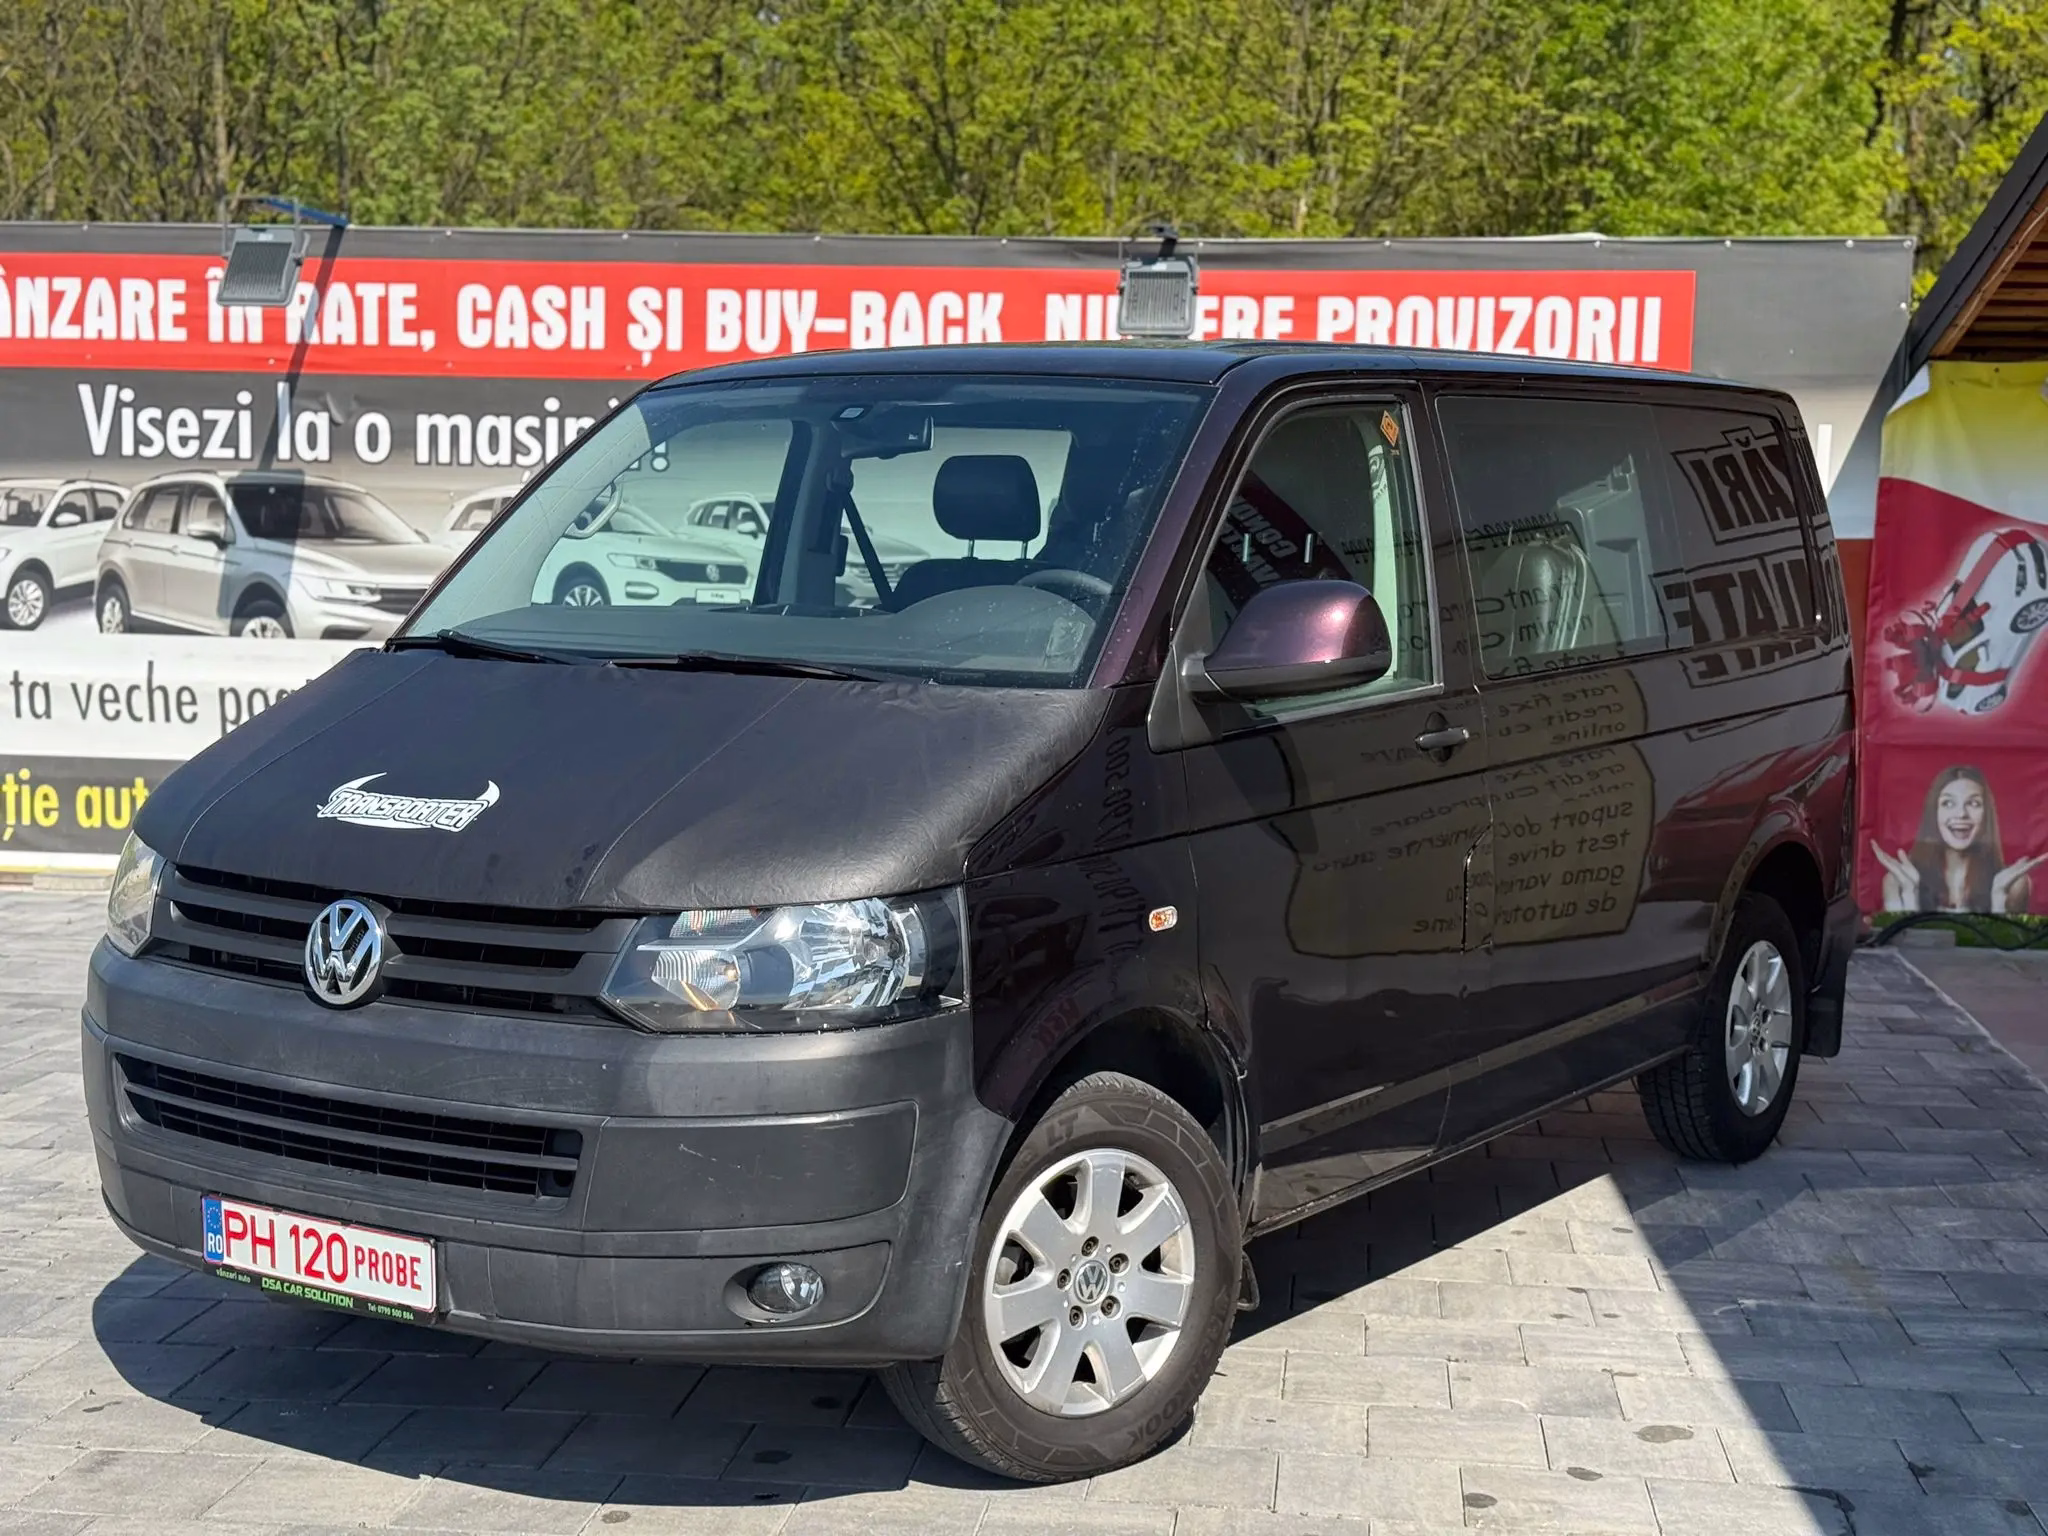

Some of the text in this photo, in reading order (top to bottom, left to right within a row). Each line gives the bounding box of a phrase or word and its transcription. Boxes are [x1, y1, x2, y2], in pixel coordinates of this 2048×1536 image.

[285, 281, 436, 352] RATE,
[455, 284, 606, 352] CASH
[626, 286, 684, 367] ȘI
[1045, 293, 1294, 342] NUERE
[1317, 294, 1662, 363] PROVIZORII
[78, 382, 254, 461] Visezi
[277, 381, 333, 464] la
[354, 412, 393, 466] o
[10, 669, 52, 721] ta
[71, 660, 199, 725] veche
[1, 767, 150, 841] ție aut
[320, 788, 487, 831] TRANSPORTER
[207, 1208, 423, 1292] RO PH 120 PROBE
[261, 1276, 283, 1293] DSA
[283, 1281, 304, 1298] CAR
[304, 1286, 355, 1309] SOLUTION
